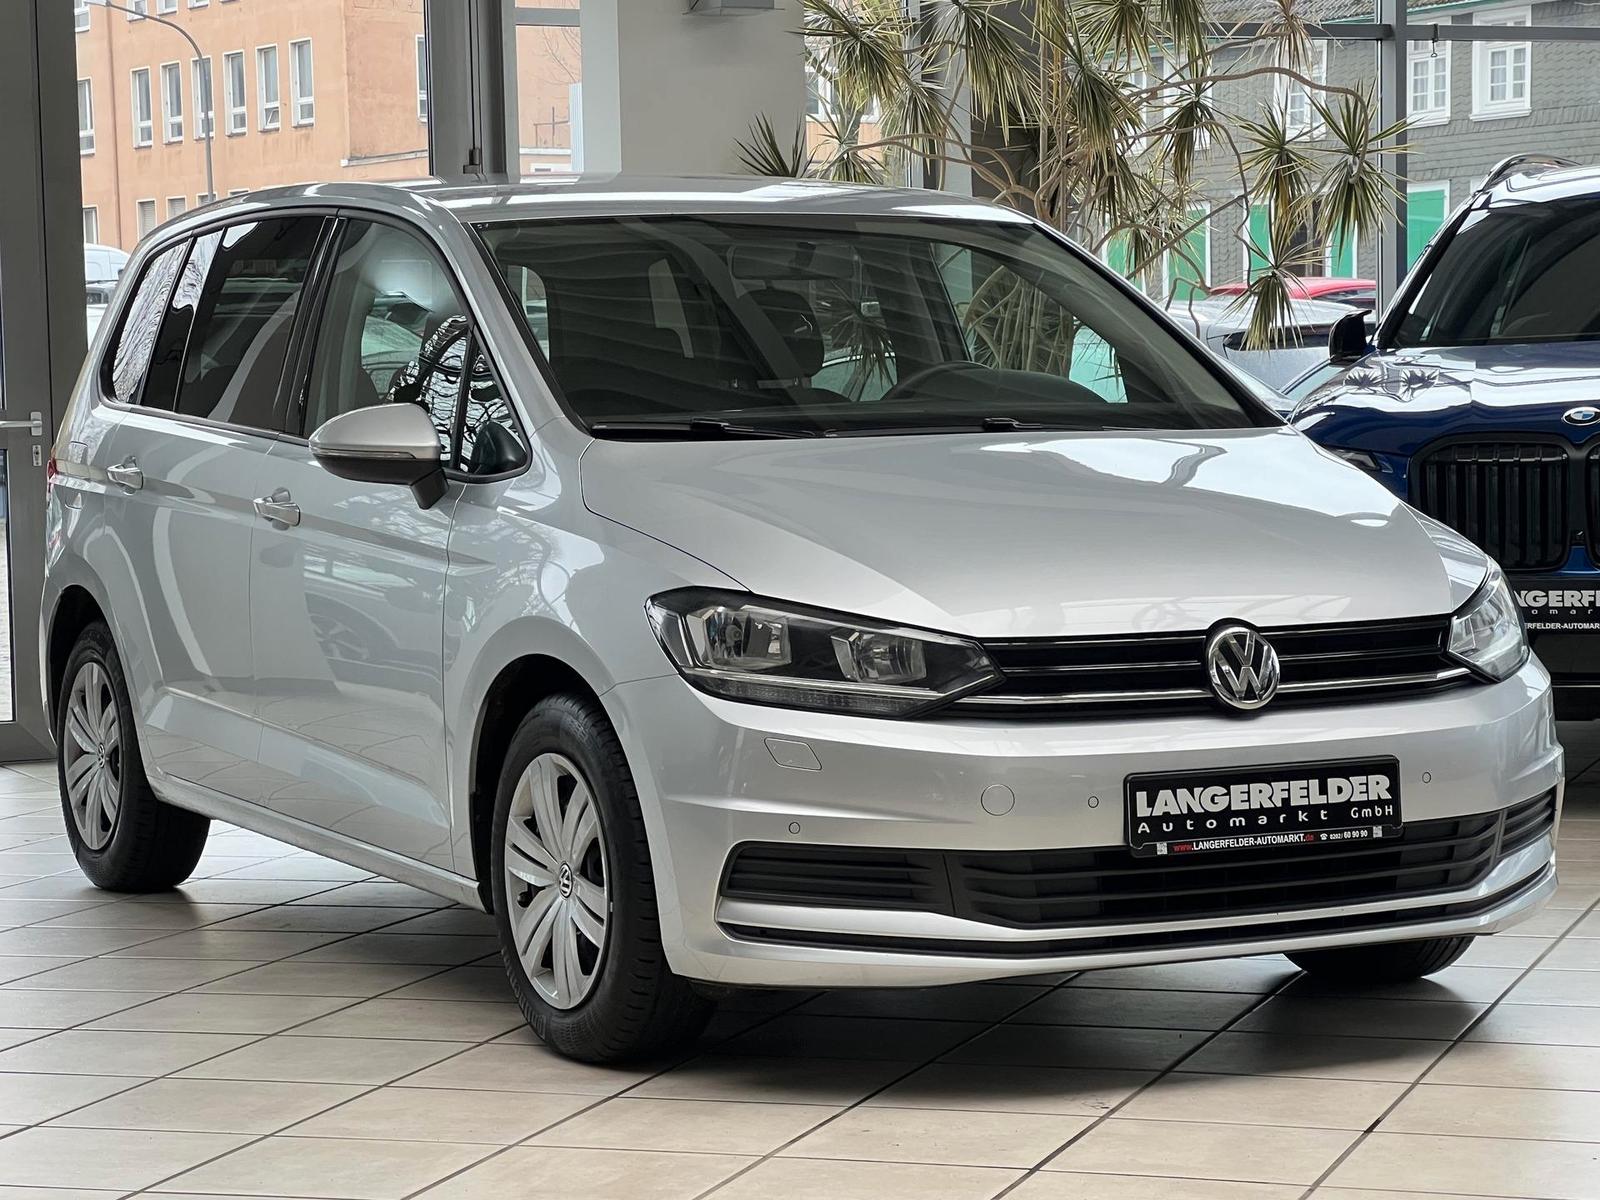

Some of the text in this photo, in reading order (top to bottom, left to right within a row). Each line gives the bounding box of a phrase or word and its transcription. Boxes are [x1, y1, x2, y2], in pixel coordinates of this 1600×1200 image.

[1513, 590, 1600, 607] NGERF
[1208, 627, 1280, 709] VW
[1136, 774, 1391, 817] LANGERFELDER
[1138, 805, 1393, 834] Automarkt GmbH
